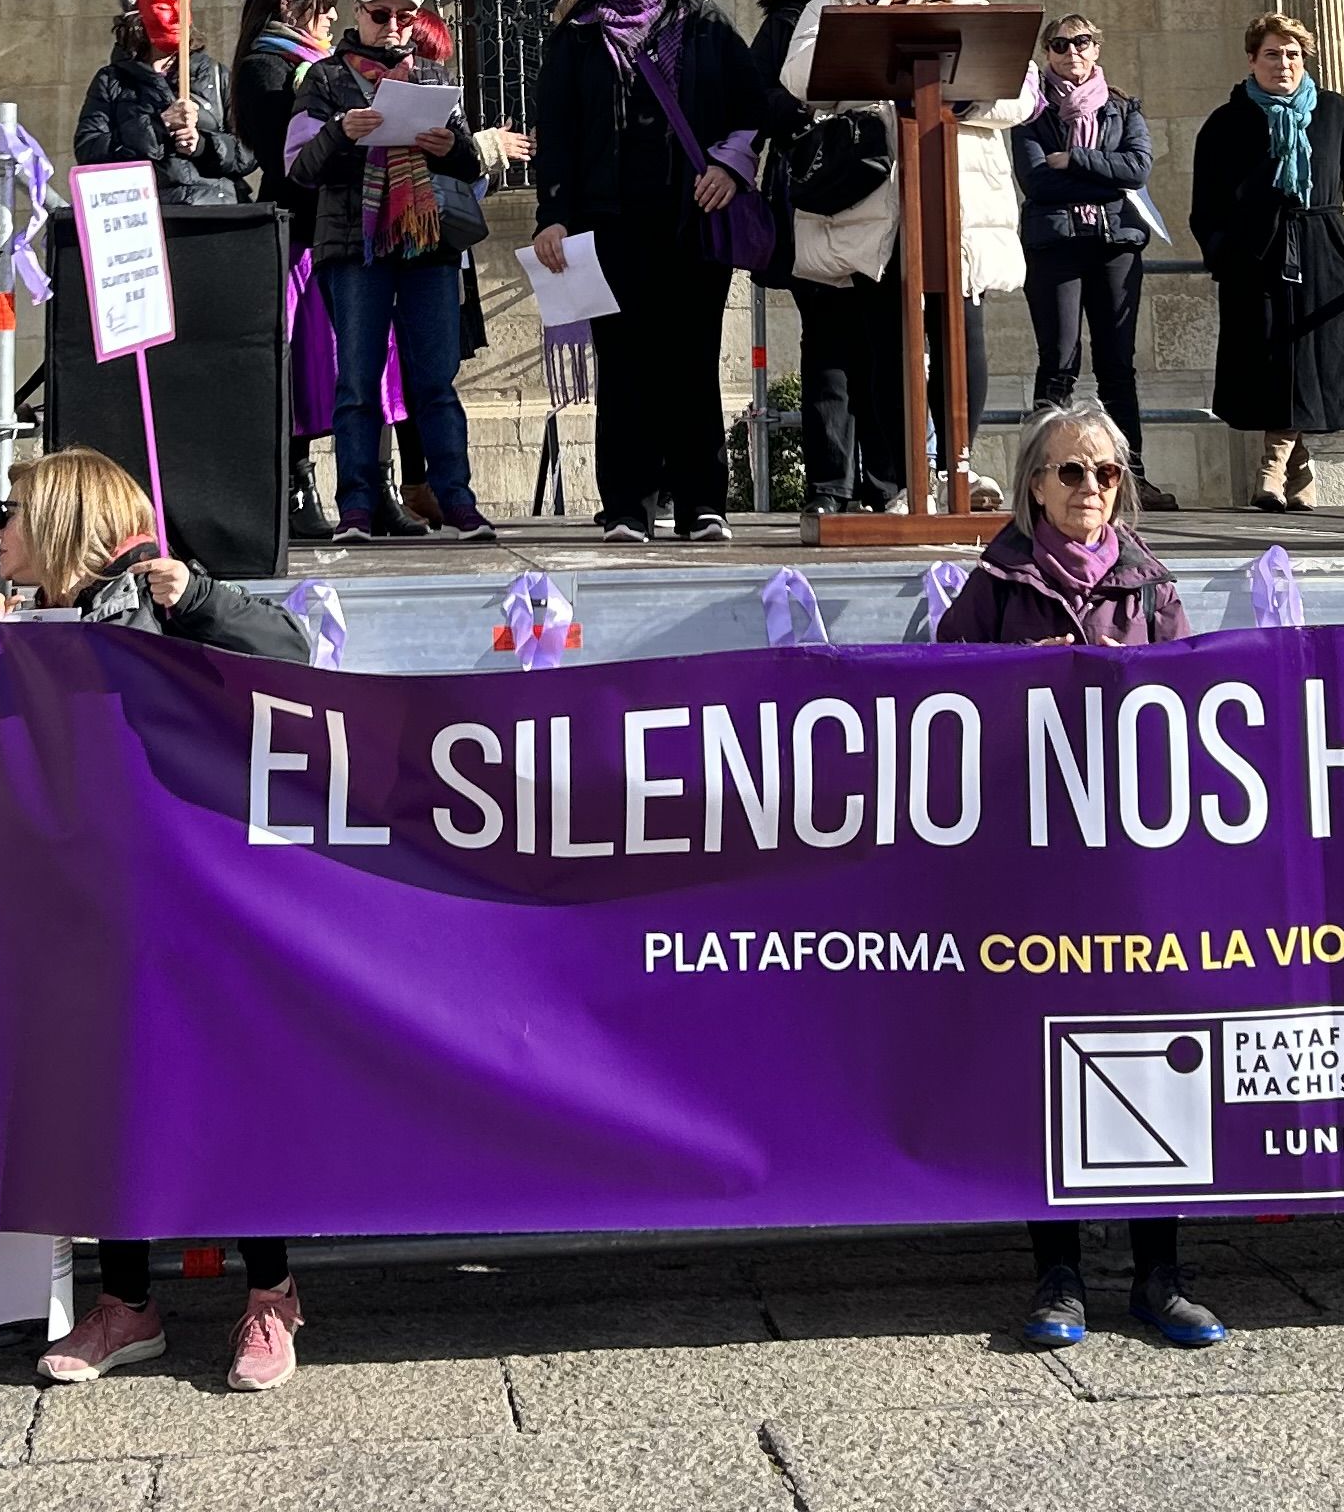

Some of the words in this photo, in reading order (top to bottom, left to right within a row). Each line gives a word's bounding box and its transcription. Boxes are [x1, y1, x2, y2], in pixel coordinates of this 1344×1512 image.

[246, 691, 390, 846] EL
[431, 696, 981, 858] SILENCIO
[1027, 680, 1269, 849] NOS
[644, 930, 965, 974] PLATAFORMA
[979, 933, 1188, 975] CONTRA
[1200, 928, 1256, 971] LA
[1235, 1051, 1272, 1073] LA
